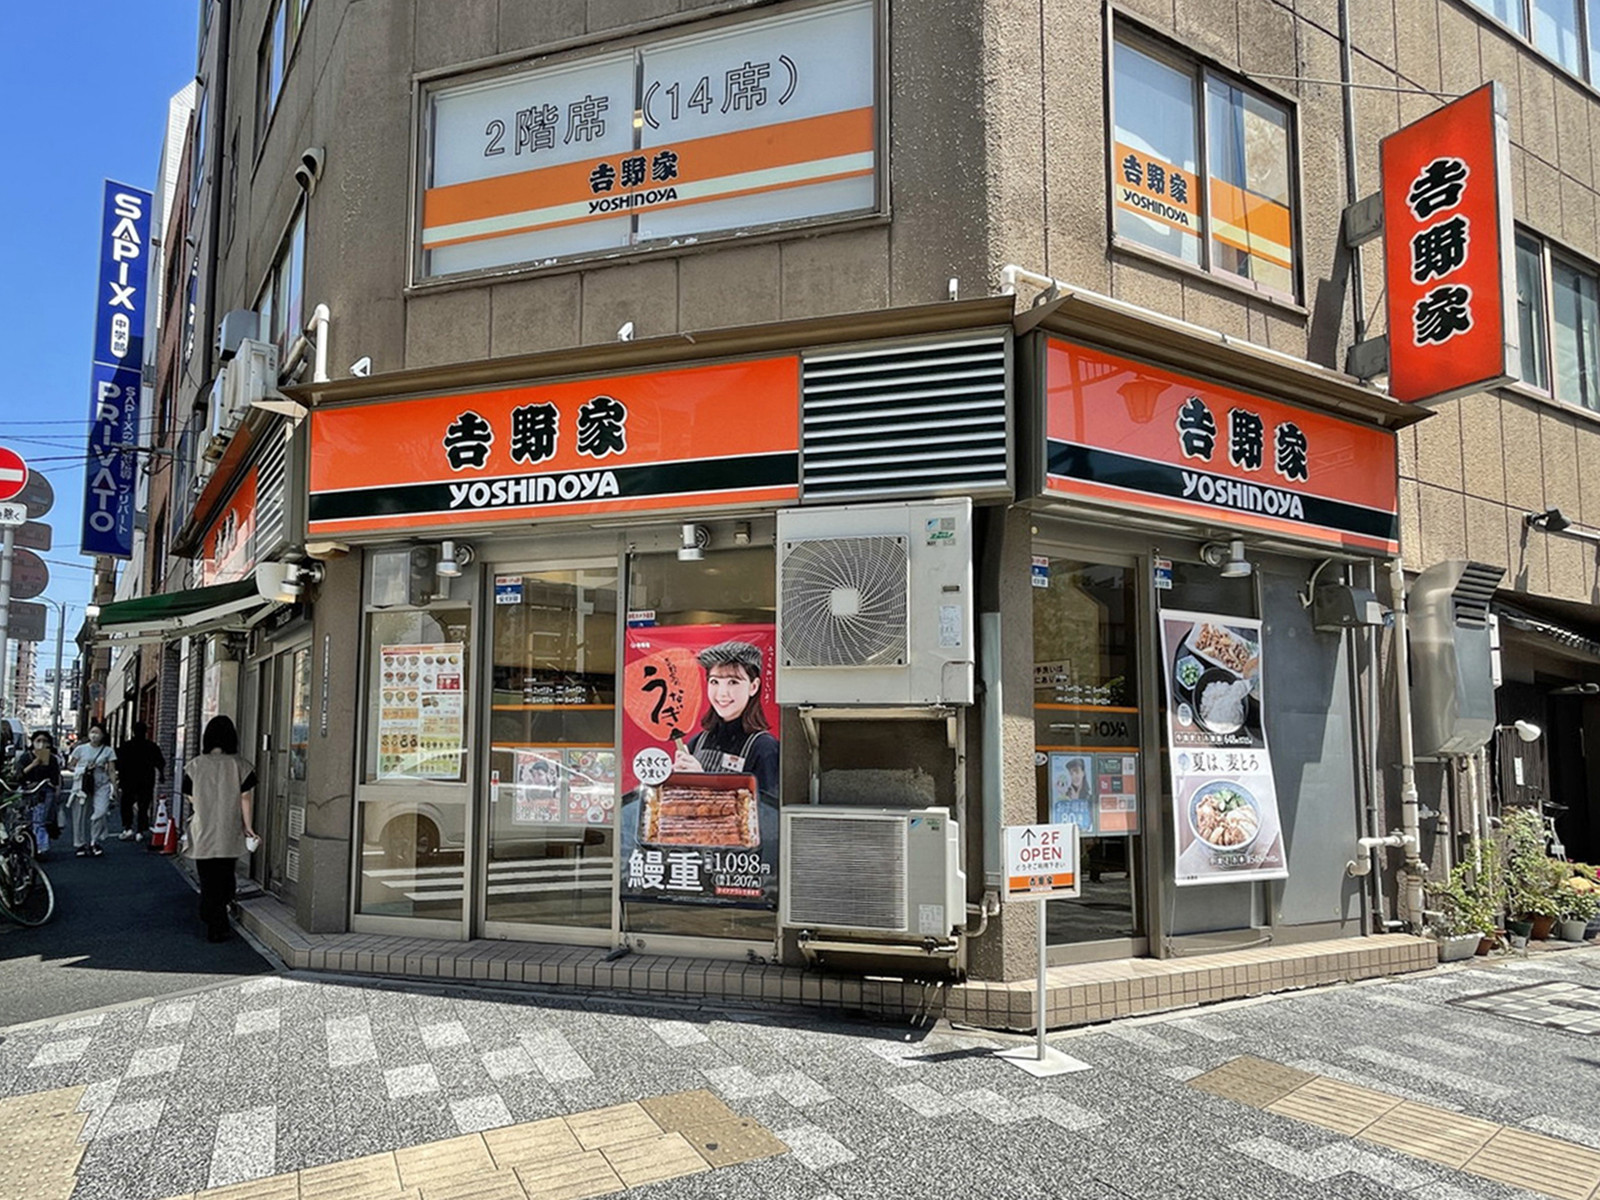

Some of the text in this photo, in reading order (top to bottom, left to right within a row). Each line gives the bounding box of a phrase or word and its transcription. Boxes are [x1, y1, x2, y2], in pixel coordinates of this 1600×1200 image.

[484, 54, 799, 157] 2階席 (14席)
[589, 151, 679, 194] 吉野家
[1122, 154, 1188, 204] 吉野家
[588, 187, 678, 214] YOSHINOYA
[1123, 188, 1189, 225] YOSHINOYA
[108, 193, 142, 311] SAPIX
[1406, 157, 1474, 347] 吉野家
[443, 395, 627, 472] 吉野家
[1176, 396, 1309, 483] 吉野家
[90, 380, 121, 533] PRIVATO
[449, 471, 620, 509] YOSHINOYA
[1182, 471, 1305, 519] YOSHINOYA
[641, 665, 685, 727] うなぎ
[635, 756, 670, 768] 大きくて
[640, 768, 666, 780] うまい
[1191, 752, 1260, 773] 夏は、麦とろ
[1020, 846, 1062, 862] OPEN
[1040, 831, 1060, 845] 2F
[628, 849, 704, 891] 鰻重
[714, 853, 771, 875] 1,098円
